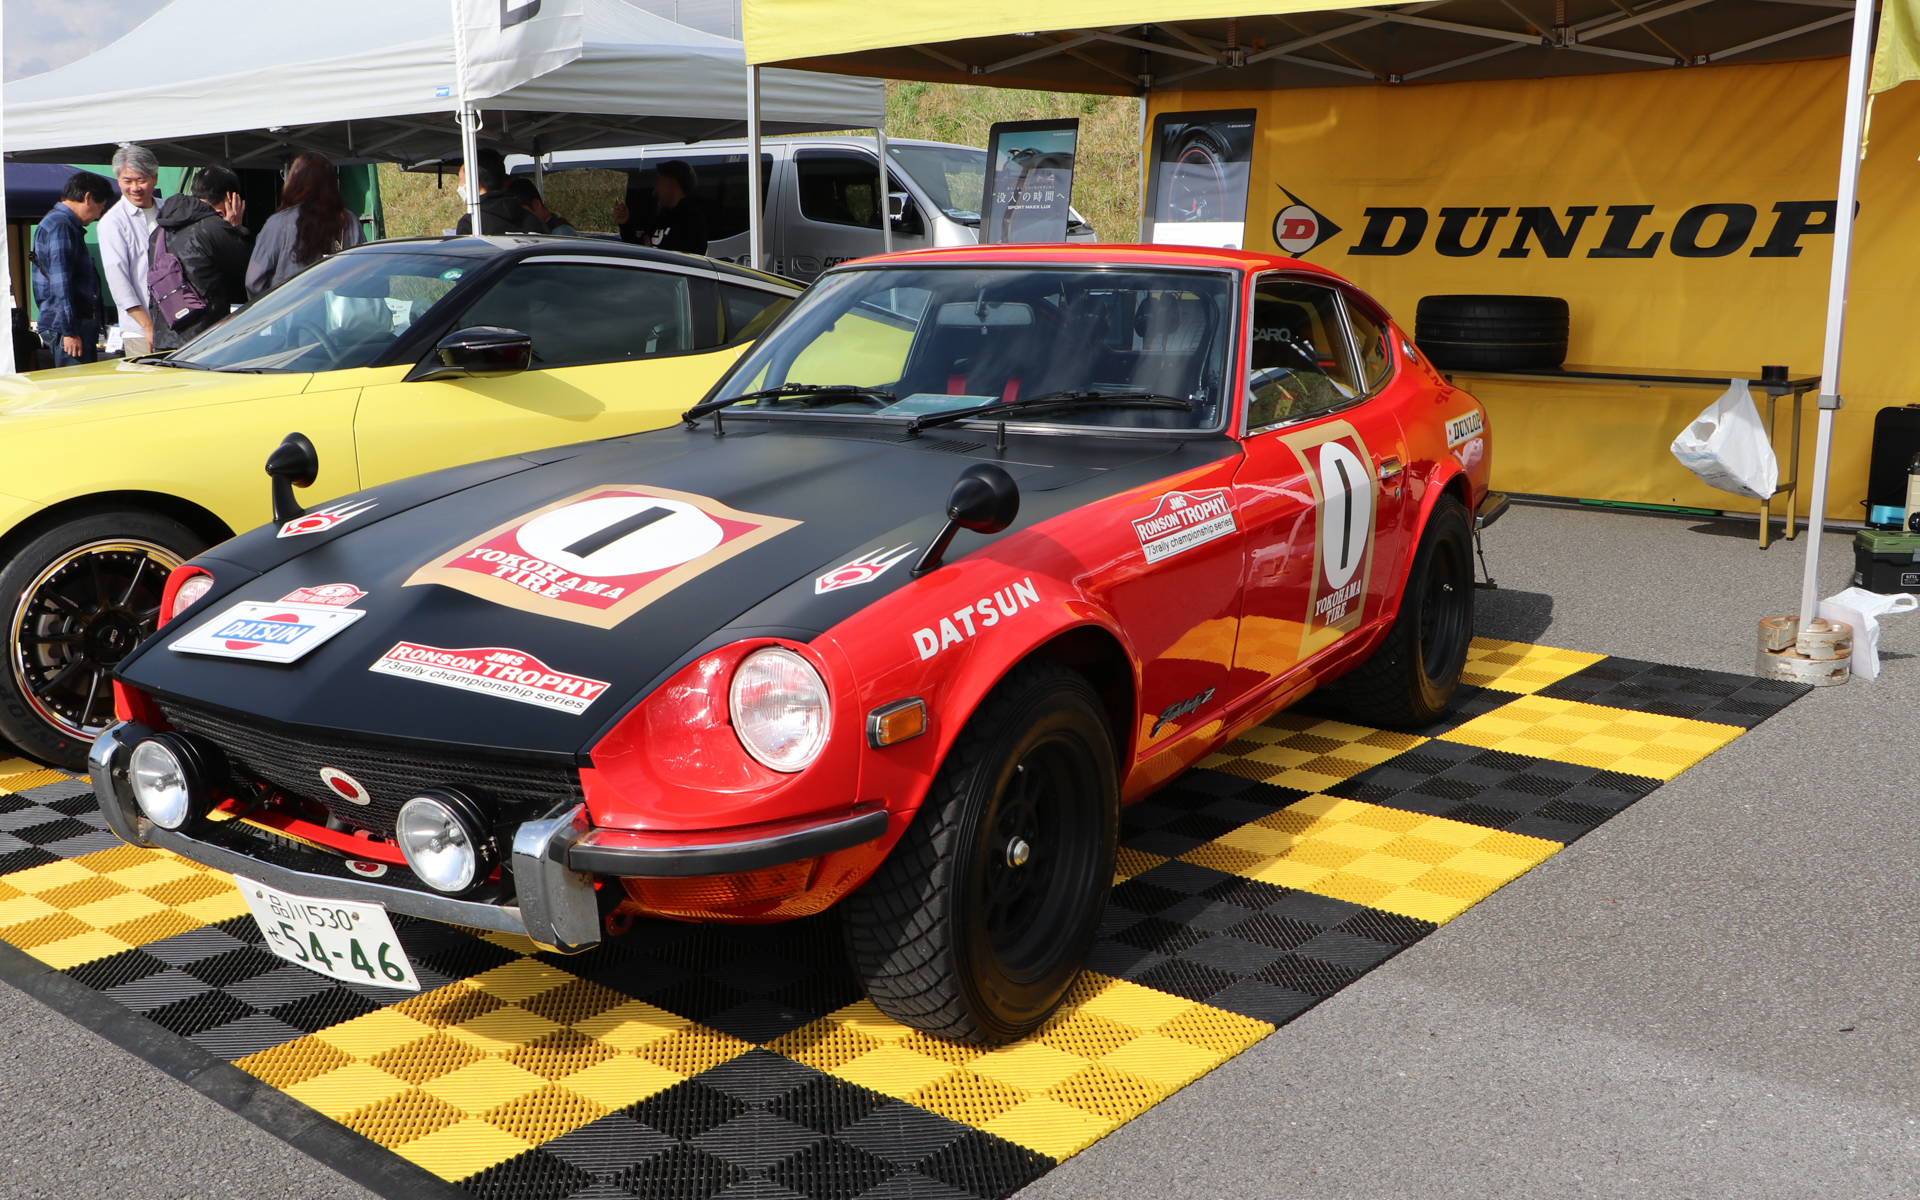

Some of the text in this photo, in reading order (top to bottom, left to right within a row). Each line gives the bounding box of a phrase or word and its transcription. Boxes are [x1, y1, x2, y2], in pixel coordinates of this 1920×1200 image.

[1346, 200, 1858, 259] DUNLOP
[1453, 413, 1481, 440] DUNLOP
[1137, 496, 1228, 542] RONSON TROPHY
[1169, 496, 1188, 511] JMS
[1334, 458, 1352, 570] 1
[561, 506, 677, 559] 1
[1170, 525, 1214, 548] championship
[1214, 517, 1233, 531] series
[466, 547, 626, 600] YOKOHAMA
[490, 565, 569, 599] TIRE
[912, 577, 1041, 661] DATSUN
[1315, 580, 1362, 617] YOKOHAMA
[1324, 602, 1347, 626] TIRE
[218, 621, 310, 643] DATSUN
[389, 646, 605, 698] RONSON TROPHY
[484, 651, 527, 666] JMS
[429, 667, 534, 698] championship
[534, 690, 586, 710] series
[277, 920, 405, 982] 54-46
